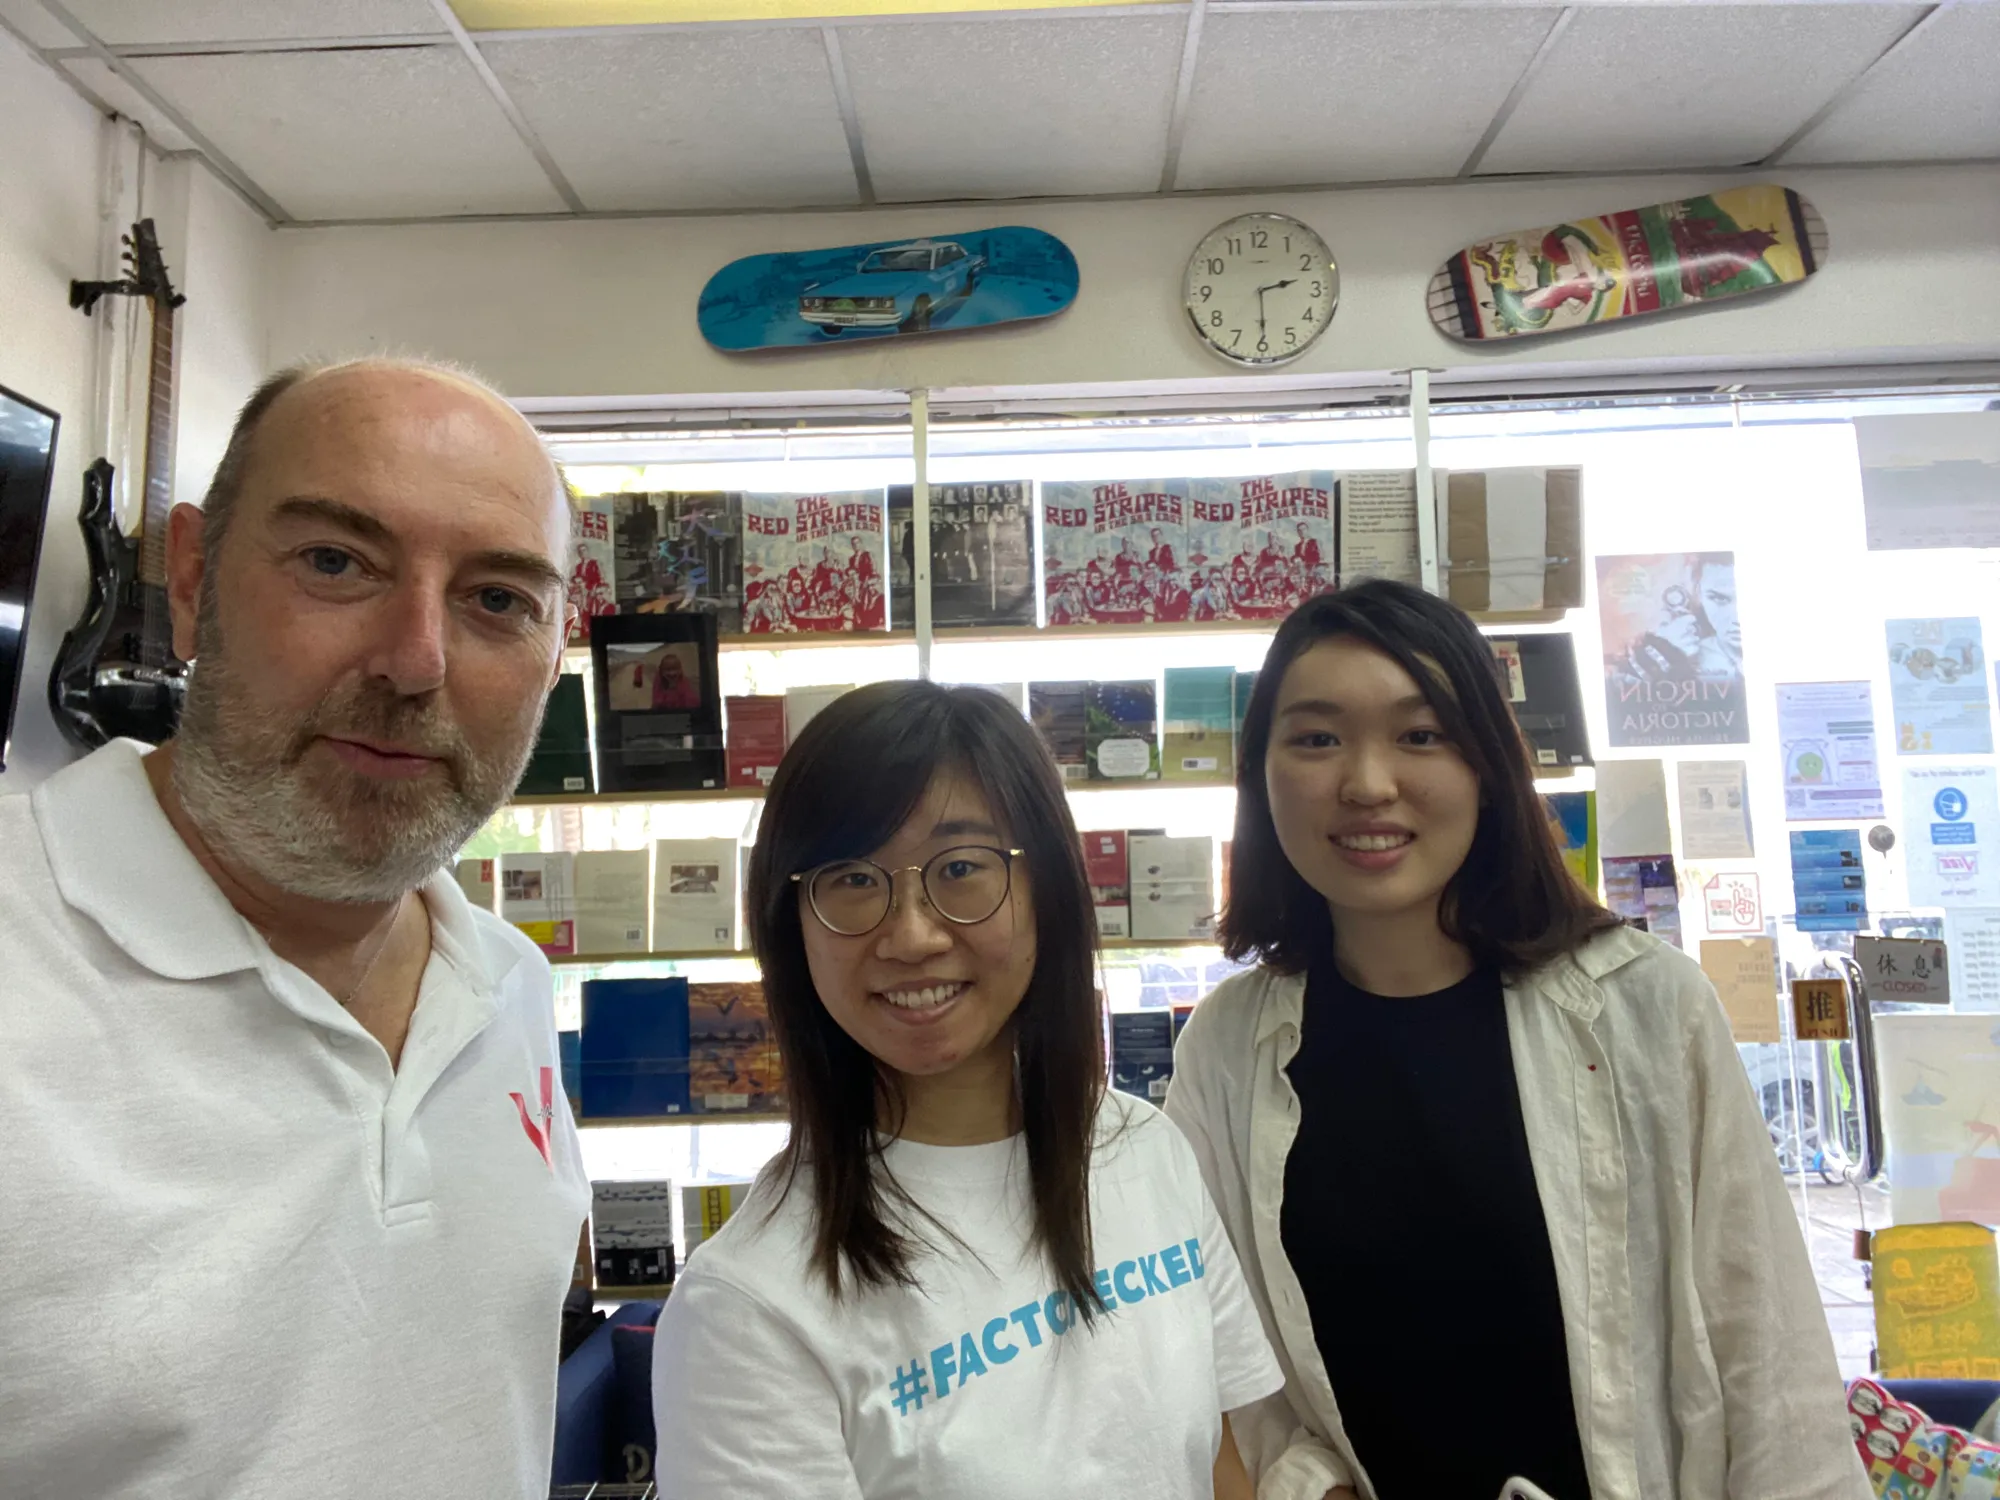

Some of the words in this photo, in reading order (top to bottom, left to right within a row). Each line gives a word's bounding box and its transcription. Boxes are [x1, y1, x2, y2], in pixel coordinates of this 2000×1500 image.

[1226, 238, 1242, 256] 11
[1250, 231, 1268, 249] 12
[1283, 237, 1290, 253] 1
[1206, 258, 1224, 275] 10
[1300, 254, 1311, 271] 2
[1200, 285, 1212, 303] 9
[1310, 281, 1322, 298] 3
[1211, 310, 1223, 327] 8
[1302, 307, 1313, 323] 4
[1230, 329, 1242, 346] 7
[1256, 335, 1269, 352] 6
[1285, 327, 1296, 344] 5
[1092, 482, 1127, 503] THE
[1240, 476, 1274, 498] THE
[795, 495, 830, 515] THE
[1045, 504, 1087, 527] RED
[1094, 493, 1182, 523] STRIPES
[1193, 499, 1234, 522] RED
[1241, 487, 1329, 518] STRIPES
[748, 514, 789, 535] RED
[796, 504, 881, 533] STRIPES
[1877, 953, 1931, 979] 休息
[1883, 980, 1927, 994] CLOSED
[1806, 990, 1835, 1022] 推
